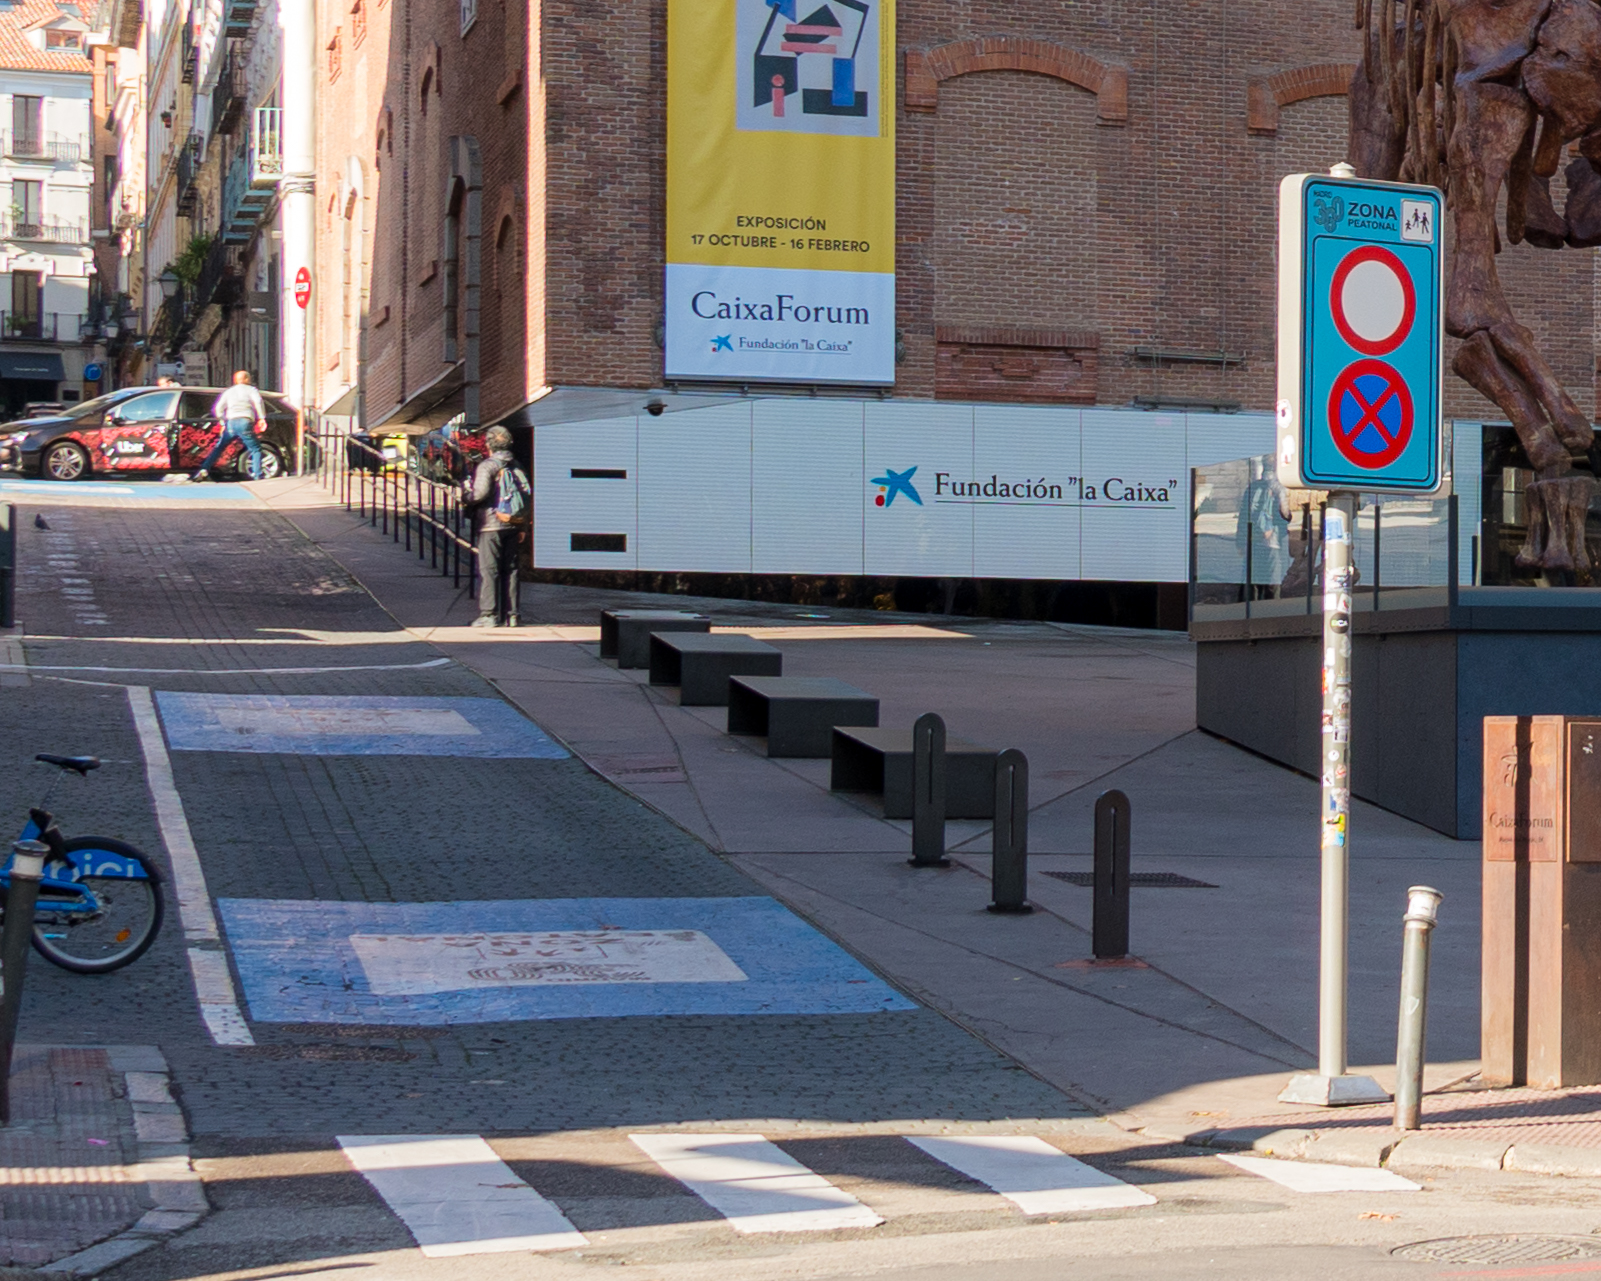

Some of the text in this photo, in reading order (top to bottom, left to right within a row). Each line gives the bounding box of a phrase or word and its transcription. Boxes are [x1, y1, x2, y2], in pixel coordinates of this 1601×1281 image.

[1348, 202, 1397, 221] ZONA
[736, 216, 826, 231] EXPOSICIÓN
[1348, 218, 1397, 231] PEATONAL
[691, 234, 704, 245] 17
[708, 234, 777, 248] OCTUBRE
[790, 238, 804, 250] 16
[808, 238, 870, 253] FEBRERO
[691, 291, 870, 325] CaixaForum
[739, 337, 799, 350] Fundación
[118, 441, 145, 453] Uber
[934, 473, 1063, 499] Fundación
